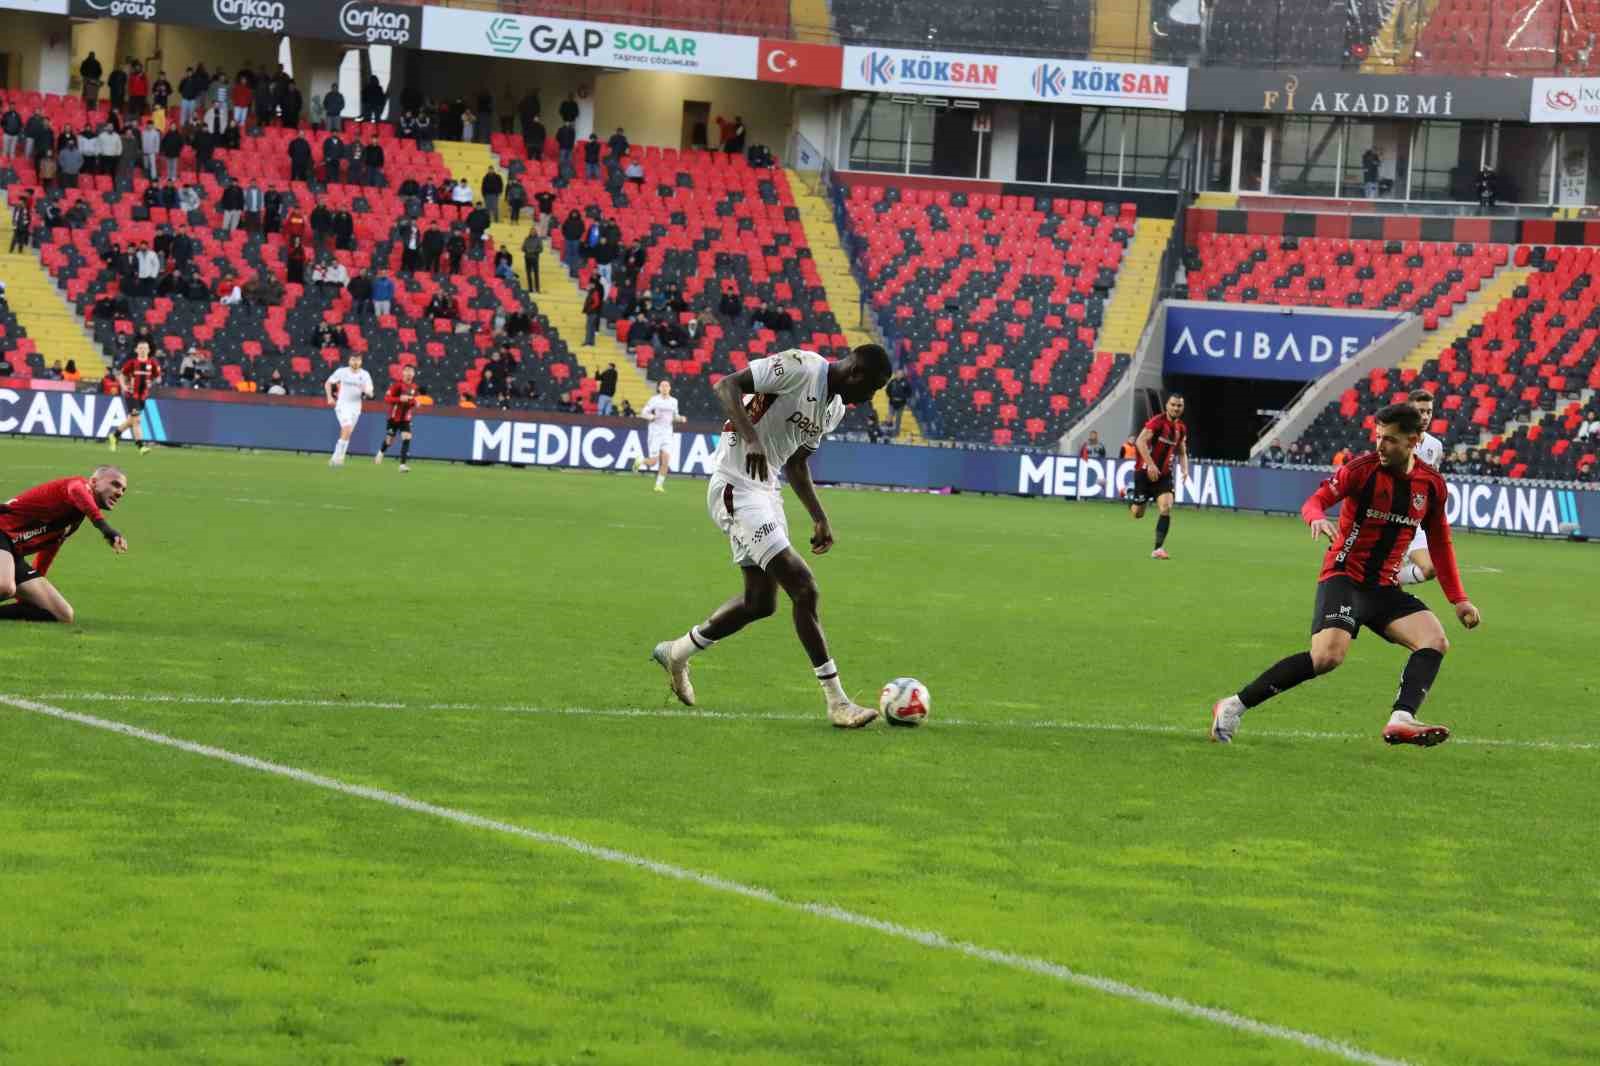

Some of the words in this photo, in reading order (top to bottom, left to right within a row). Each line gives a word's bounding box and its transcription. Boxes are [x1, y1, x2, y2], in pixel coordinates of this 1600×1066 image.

[110, 1, 156, 19] group
[240, 16, 285, 33] group
[365, 25, 410, 44] group
[529, 24, 603, 57] GAP
[613, 31, 697, 56] SOLAR
[899, 55, 998, 86] KÖKSAN
[1072, 66, 1170, 96] KÖKSAN
[1311, 91, 1453, 115] AKADEMİ
[1171, 325, 1376, 364] ACIBADE
[0, 388, 132, 439] CANA
[1018, 454, 1219, 506] MEDICNA
[1445, 483, 1560, 534] DICANA
